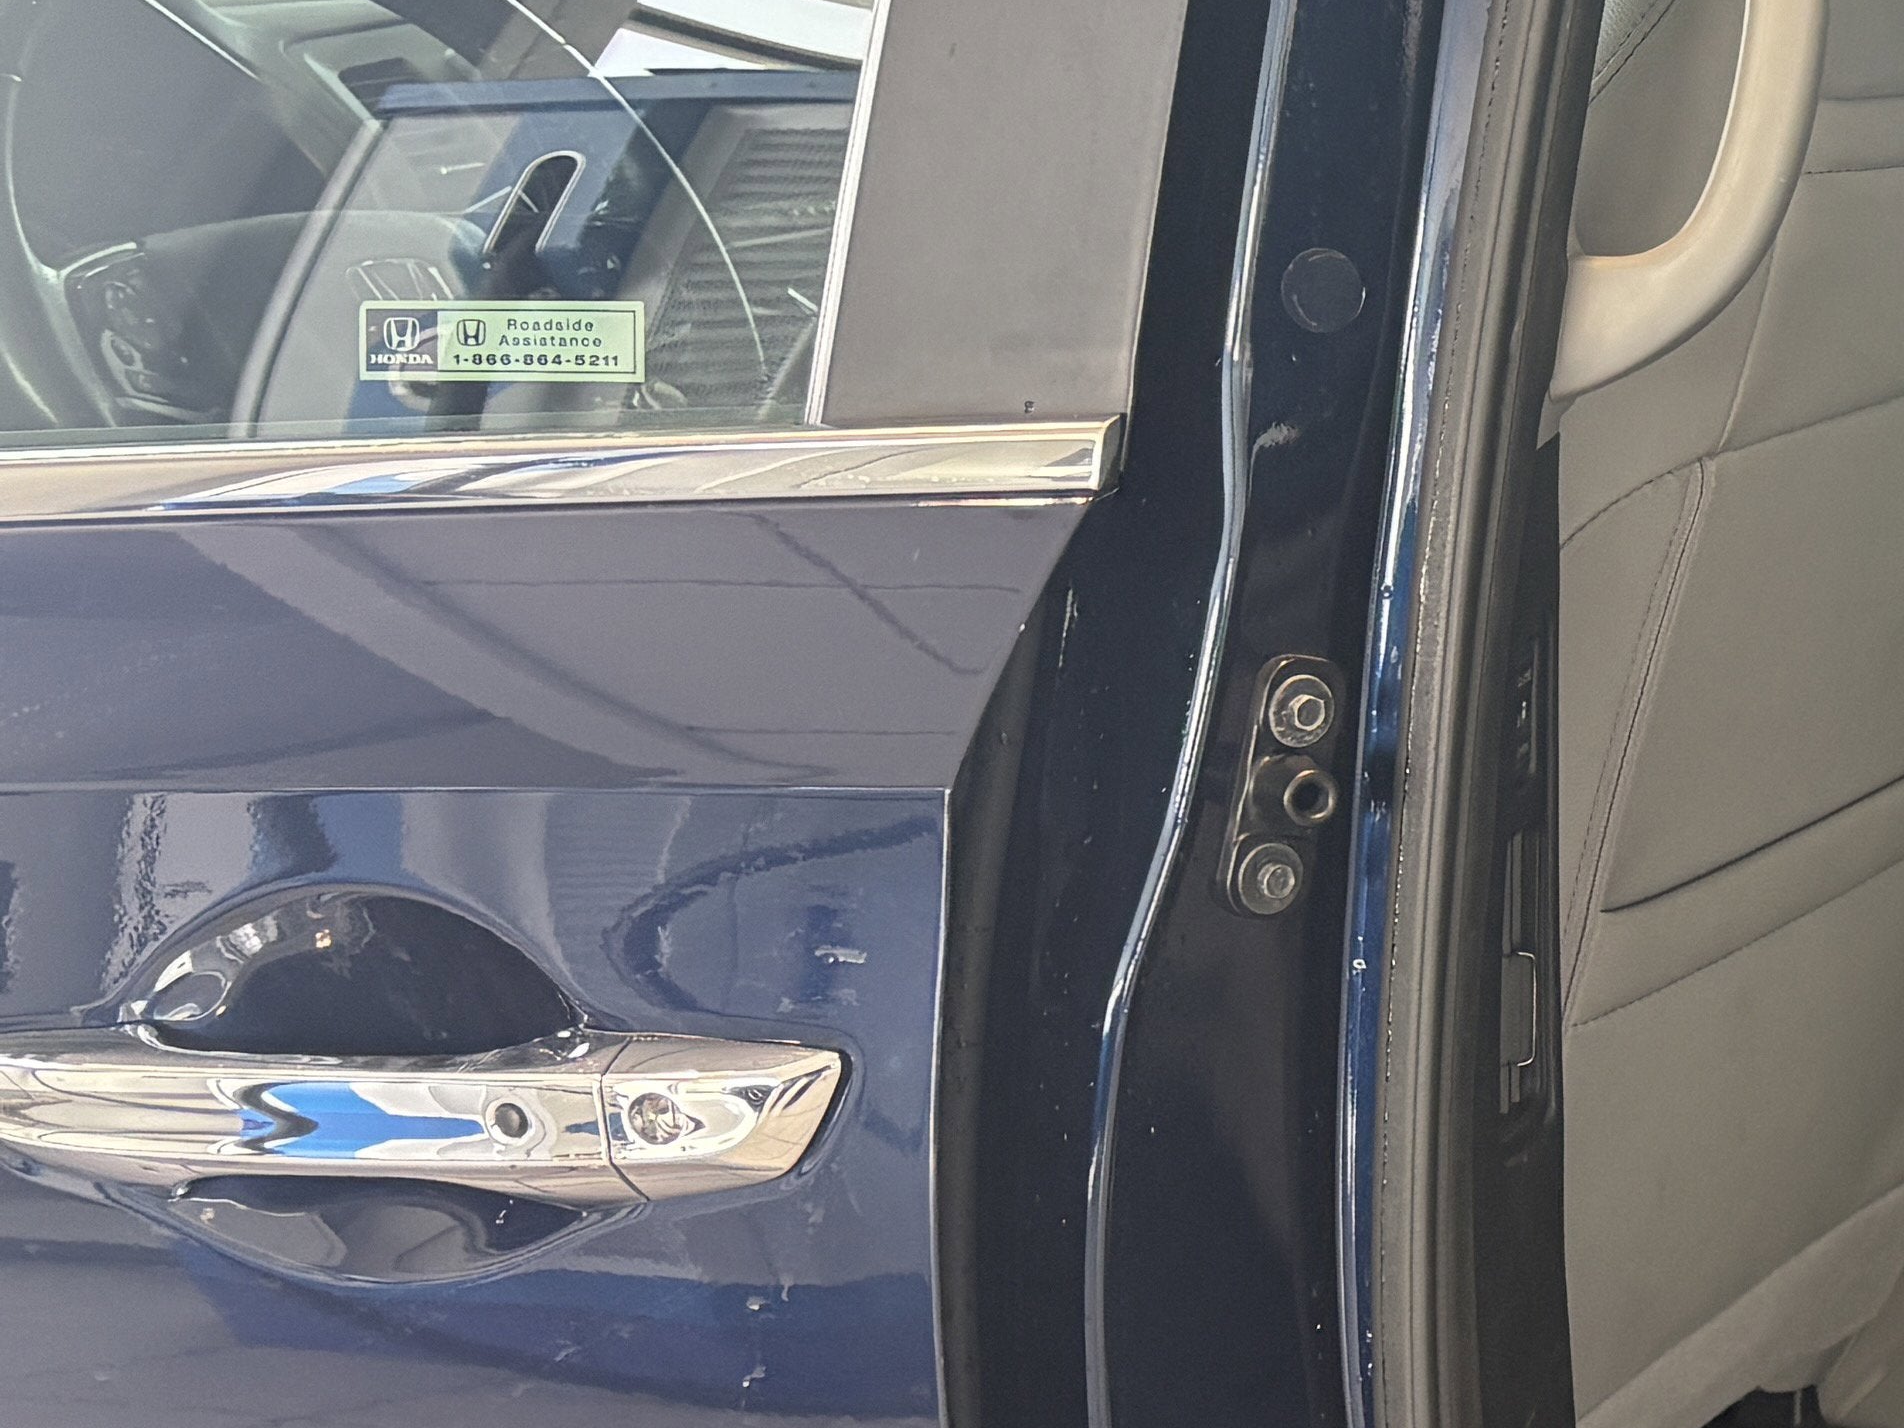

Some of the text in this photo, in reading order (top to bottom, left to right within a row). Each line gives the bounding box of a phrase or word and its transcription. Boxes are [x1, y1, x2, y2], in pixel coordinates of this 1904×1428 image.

[507, 318, 594, 332] Roadside
[499, 334, 602, 348] Assistance
[370, 353, 434, 365] HONDA
[453, 354, 620, 367] 1-866-864-5211
